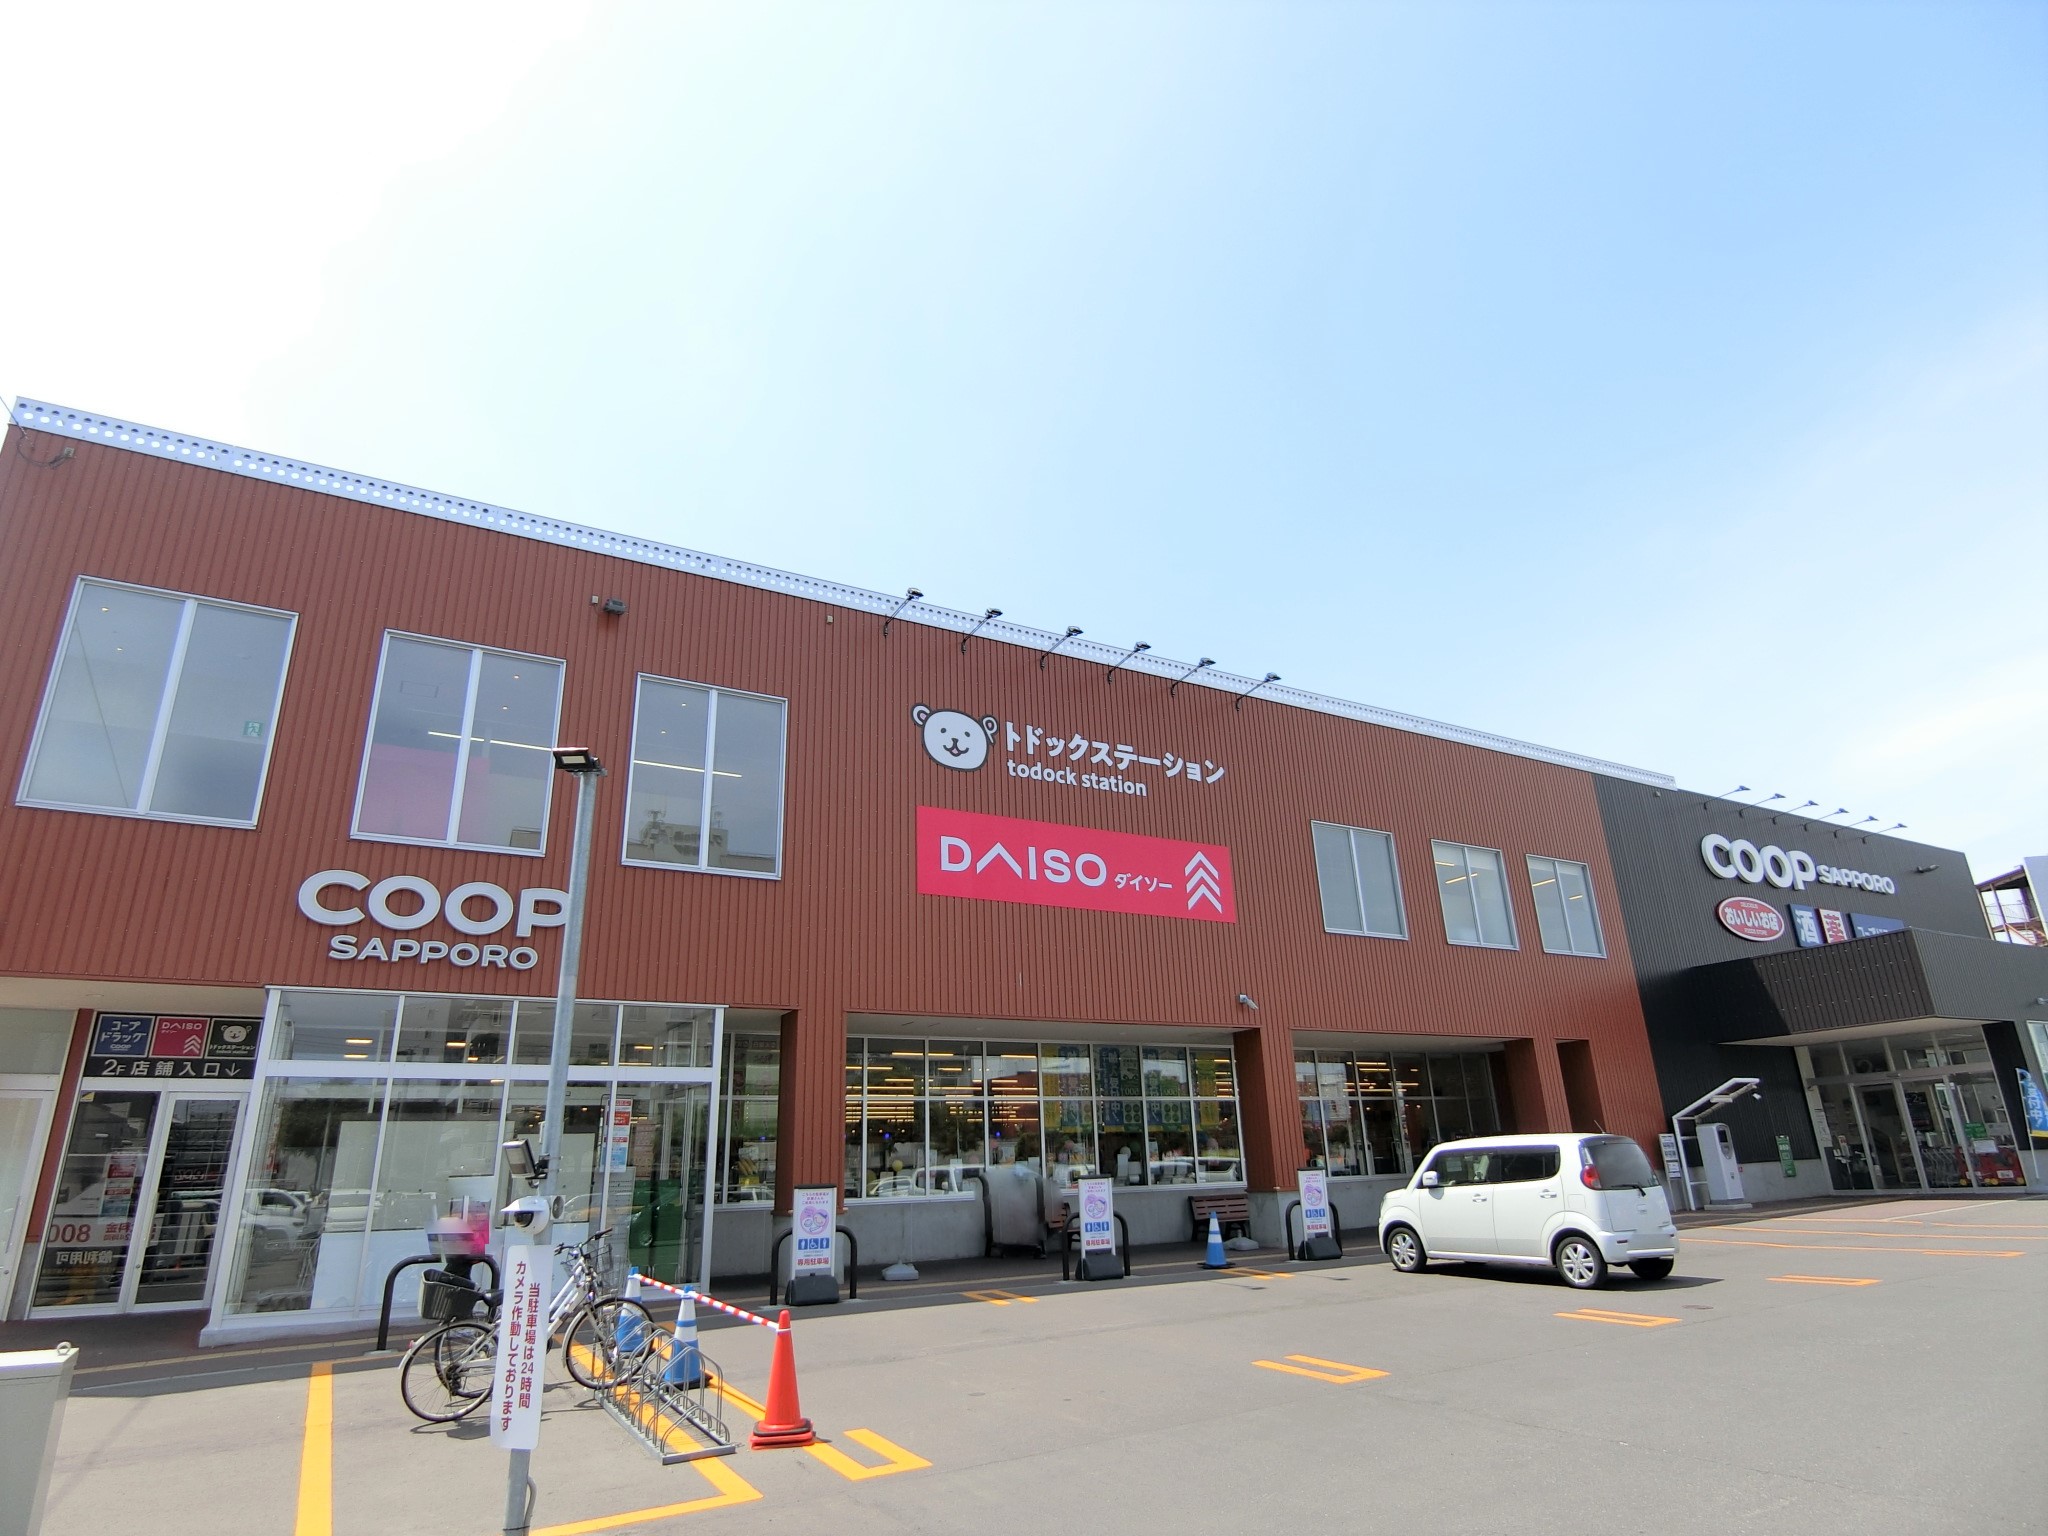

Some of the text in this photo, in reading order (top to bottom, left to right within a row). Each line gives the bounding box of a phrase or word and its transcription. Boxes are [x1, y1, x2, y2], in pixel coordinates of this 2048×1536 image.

[1005, 721, 1225, 785] トドックステーション
[1007, 759, 1147, 797] todock station
[940, 835, 1107, 888] DAISO
[1701, 833, 1896, 895] COOP SAPPORO
[1114, 873, 1173, 893] ダイソー
[298, 869, 570, 938] COOP
[1724, 906, 1780, 931] おいしいお店
[1795, 909, 1820, 944] 酒
[328, 934, 539, 971] SAPPORO
[100, 1031, 147, 1043] ドラッグ
[111, 1020, 142, 1031] コープ
[161, 1021, 203, 1031] DAISO
[797, 1256, 830, 1266] 専用駐車場
[502, 1260, 527, 1432] カメラ作動しております
[518, 1282, 541, 1409] 当駐車場は24時間
